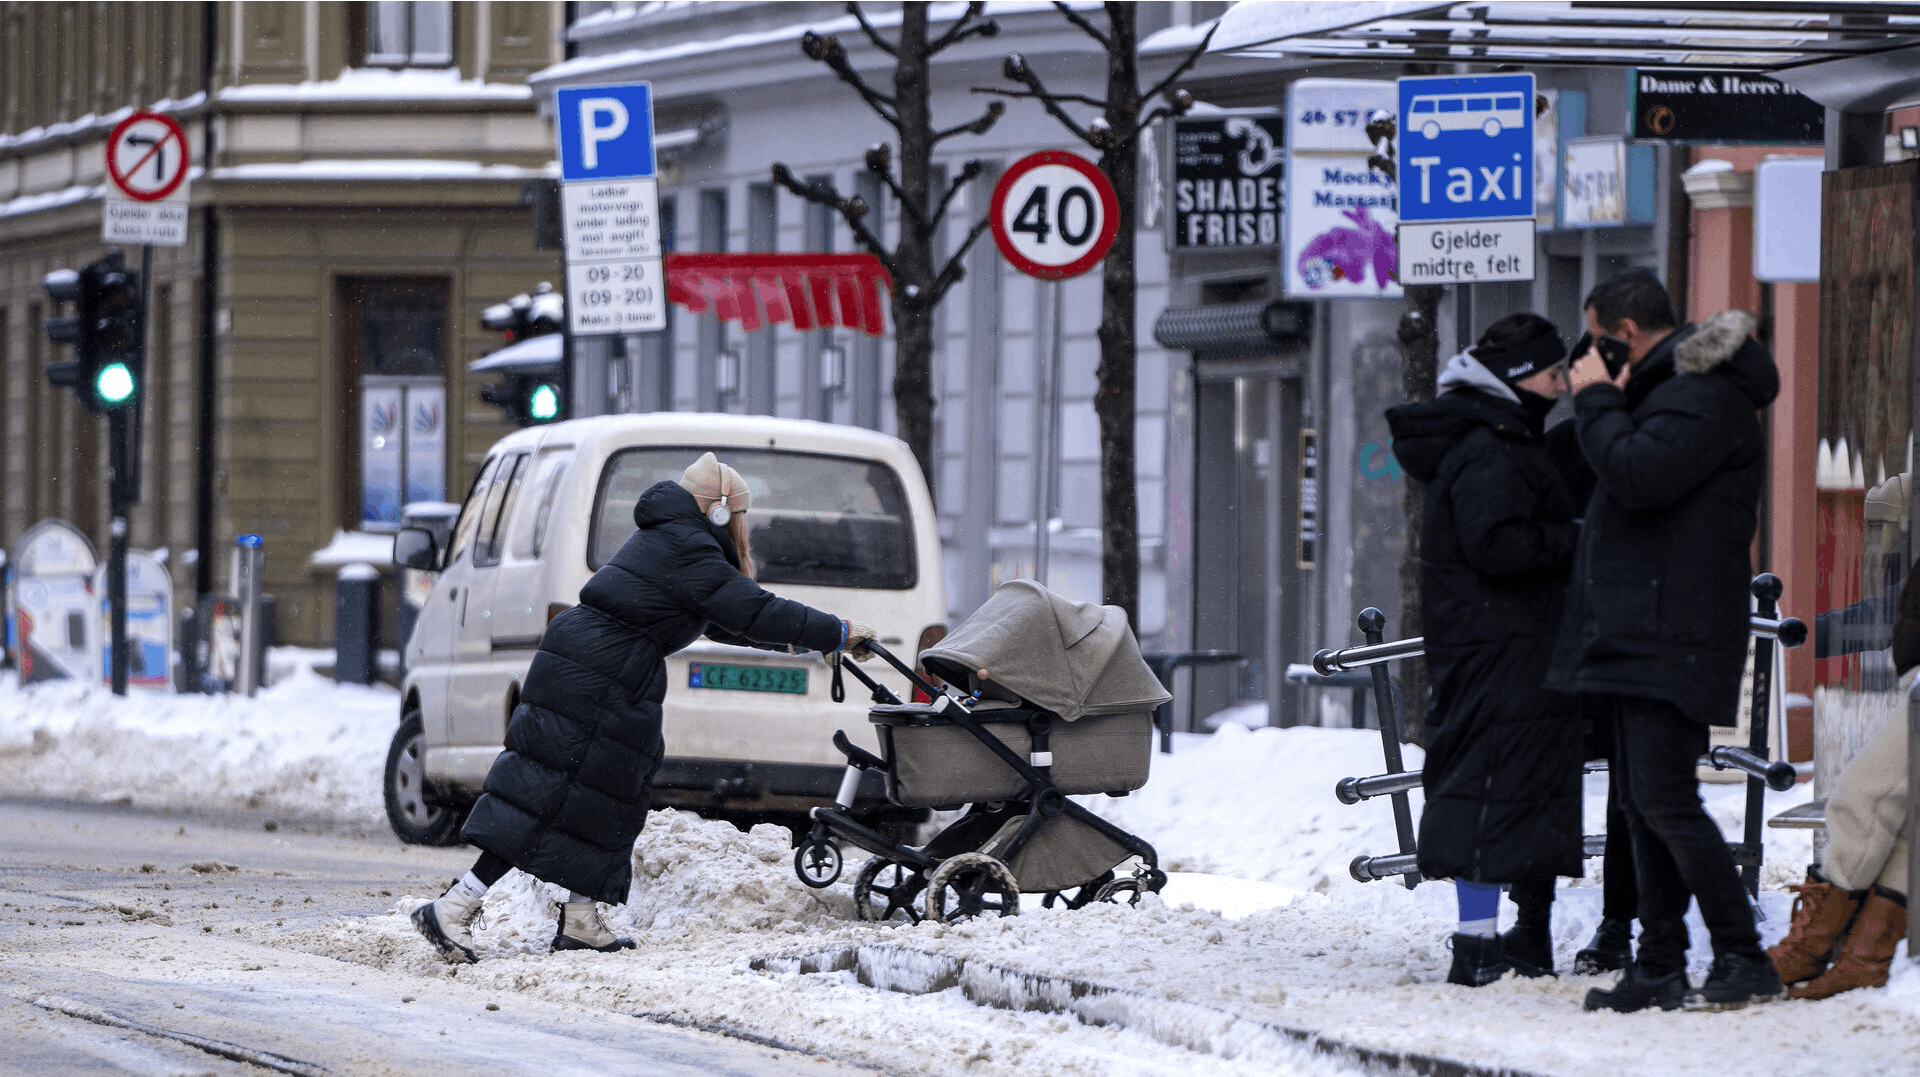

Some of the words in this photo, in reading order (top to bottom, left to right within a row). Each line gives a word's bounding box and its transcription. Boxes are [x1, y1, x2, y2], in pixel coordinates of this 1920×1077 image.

[1639, 75, 1696, 94] Dame
[1699, 74, 1719, 94] &
[1722, 76, 1781, 94] Herre
[579, 97, 630, 170] P
[1409, 152, 1522, 204] Taxi
[1012, 184, 1095, 246] 40
[1187, 211, 1287, 247] FRISØ
[1431, 229, 1502, 254] Gjelder
[1413, 257, 1476, 279] midtre
[1487, 254, 1521, 275] felt
